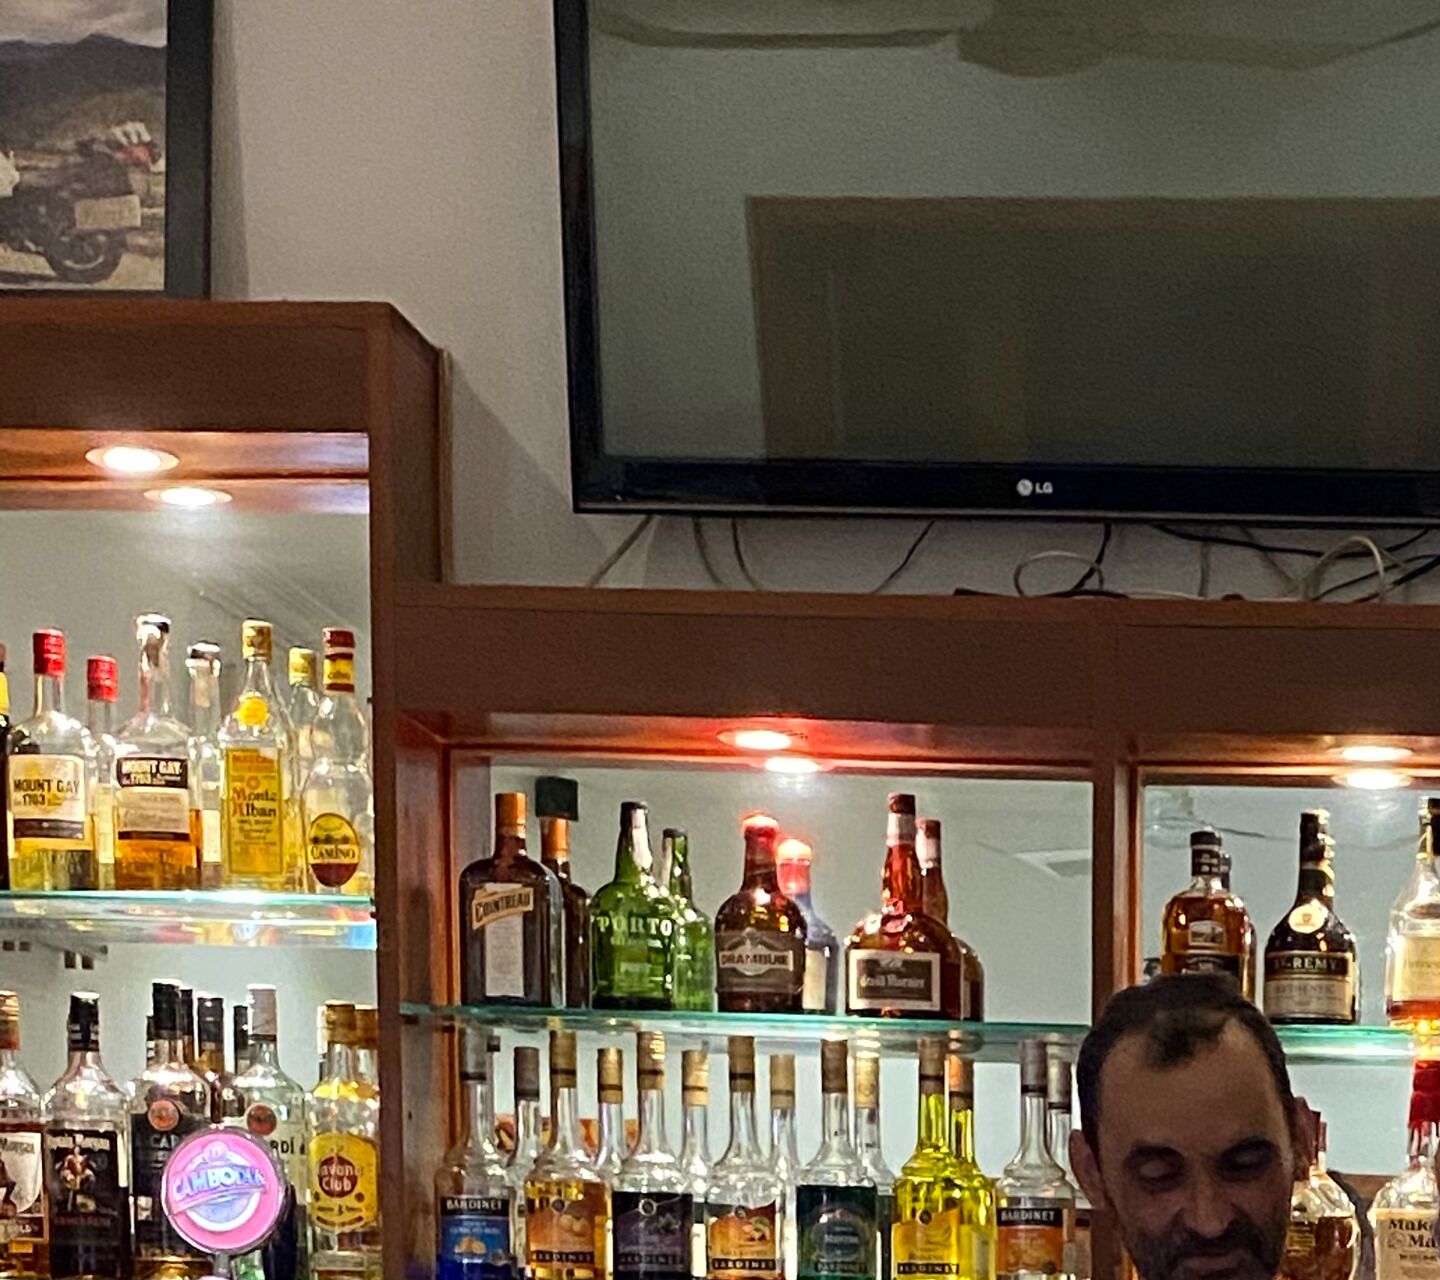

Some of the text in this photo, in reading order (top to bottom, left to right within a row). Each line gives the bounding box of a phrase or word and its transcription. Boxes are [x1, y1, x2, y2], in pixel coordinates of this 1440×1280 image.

[1034, 481, 1053, 494] LG
[13, 779, 79, 795] MOUNT GAY
[321, 1177, 352, 1191] Club
[1000, 1210, 1056, 1222] BARDINET
